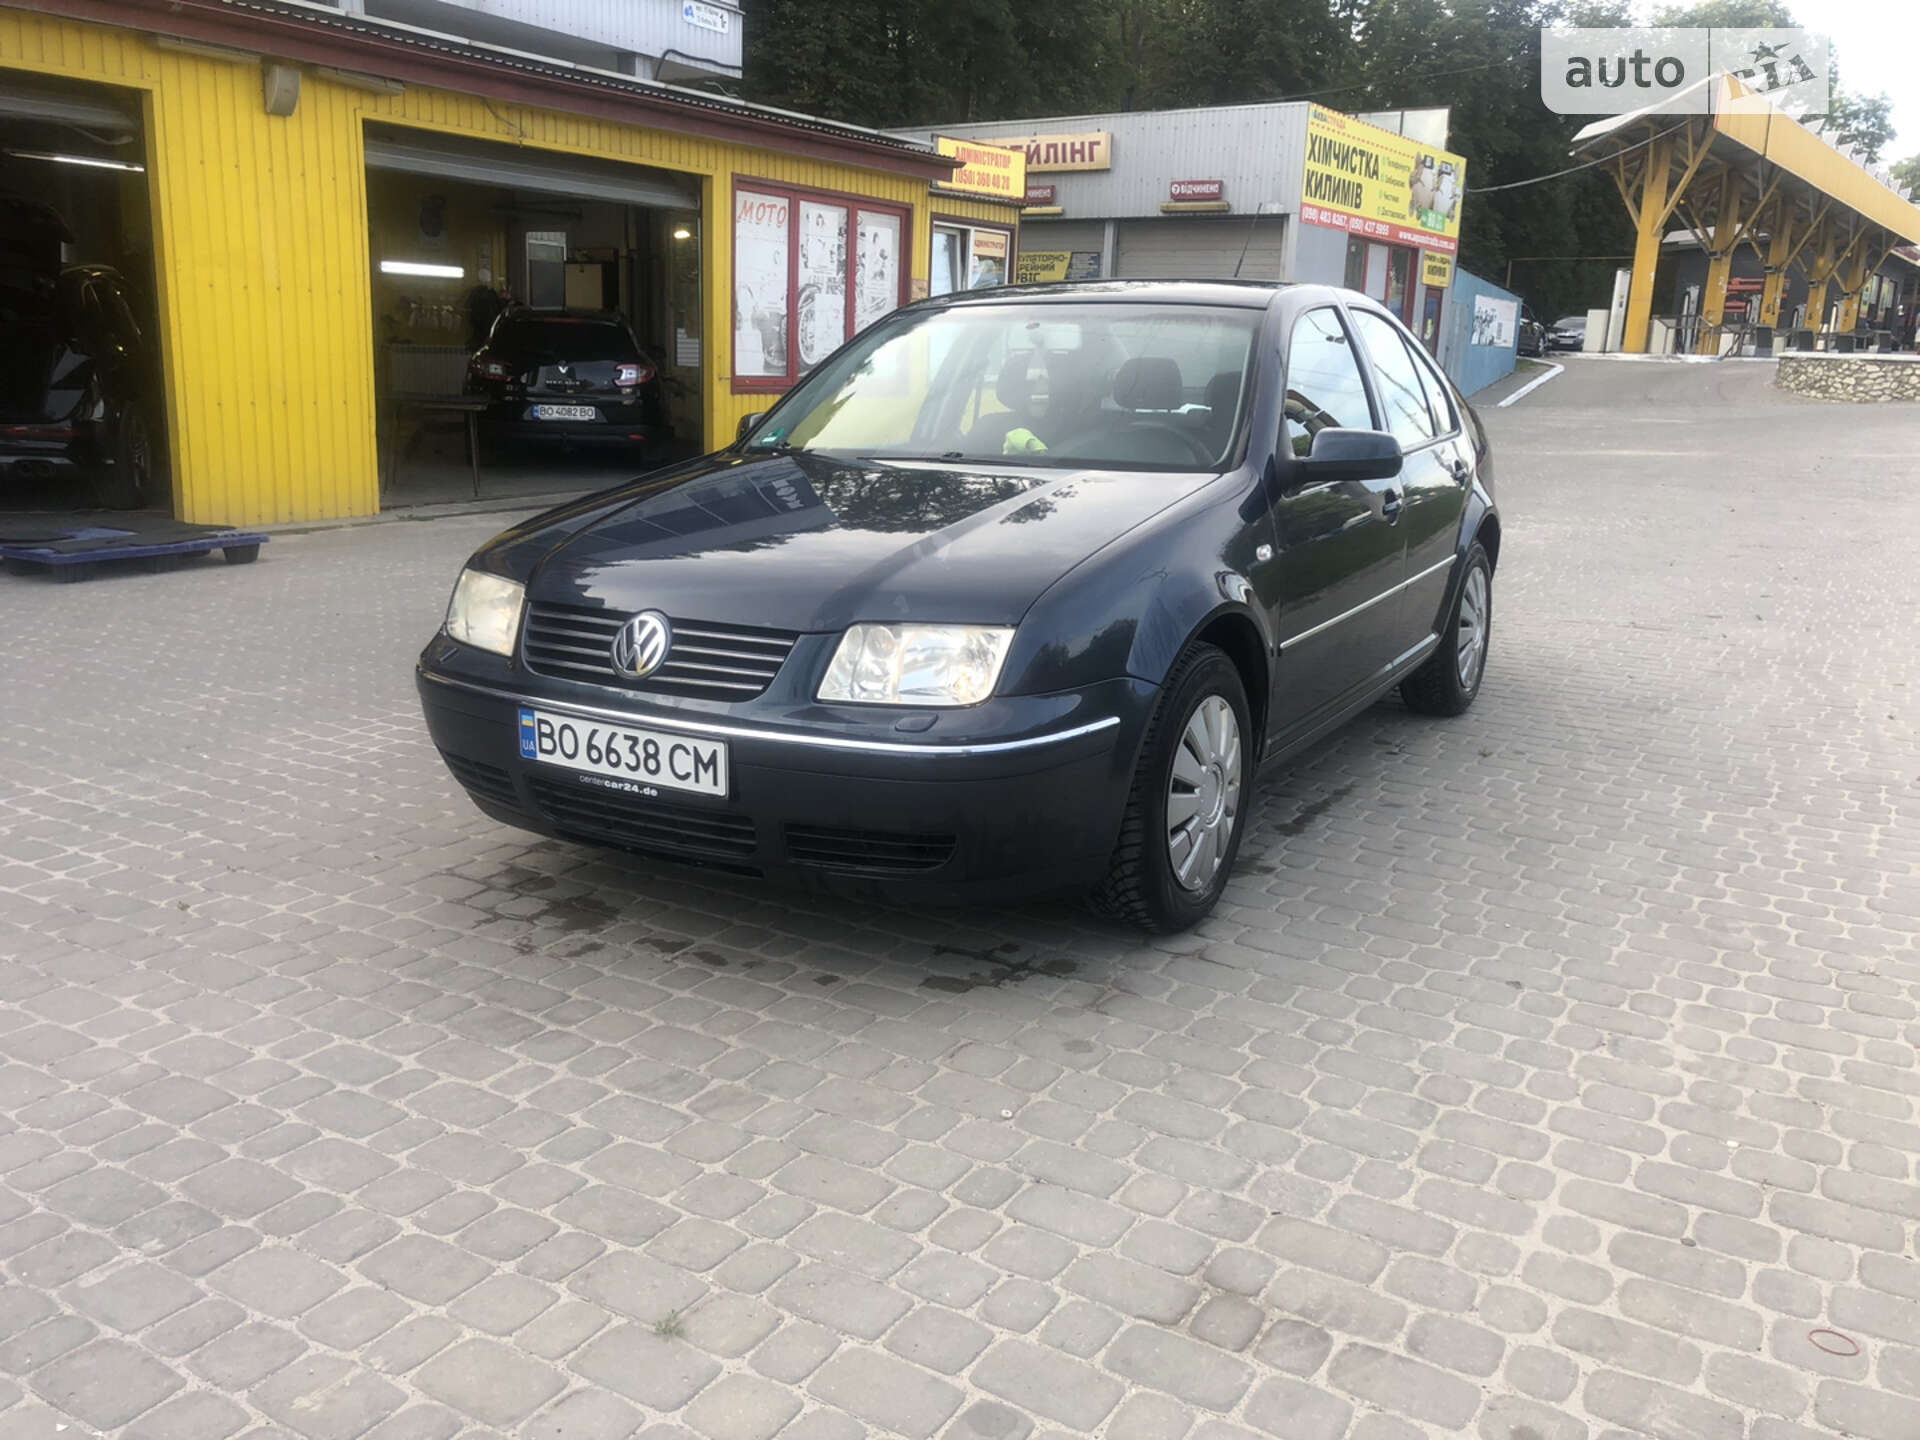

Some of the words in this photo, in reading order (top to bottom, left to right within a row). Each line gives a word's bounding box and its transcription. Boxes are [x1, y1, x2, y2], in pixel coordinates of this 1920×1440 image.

[955, 146, 1011, 169] АДМІНІСТРАТОР
[1009, 140, 1101, 166] ЙЛІНГ
[1308, 132, 1379, 181] ХІМЧИСТКА
[1305, 168, 1363, 209] КИЛИМІВ
[522, 740, 536, 751] UA
[536, 717, 580, 761] BO
[586, 728, 661, 776] 6638
[668, 742, 719, 787] CM
[579, 774, 659, 797] centercar24.de
